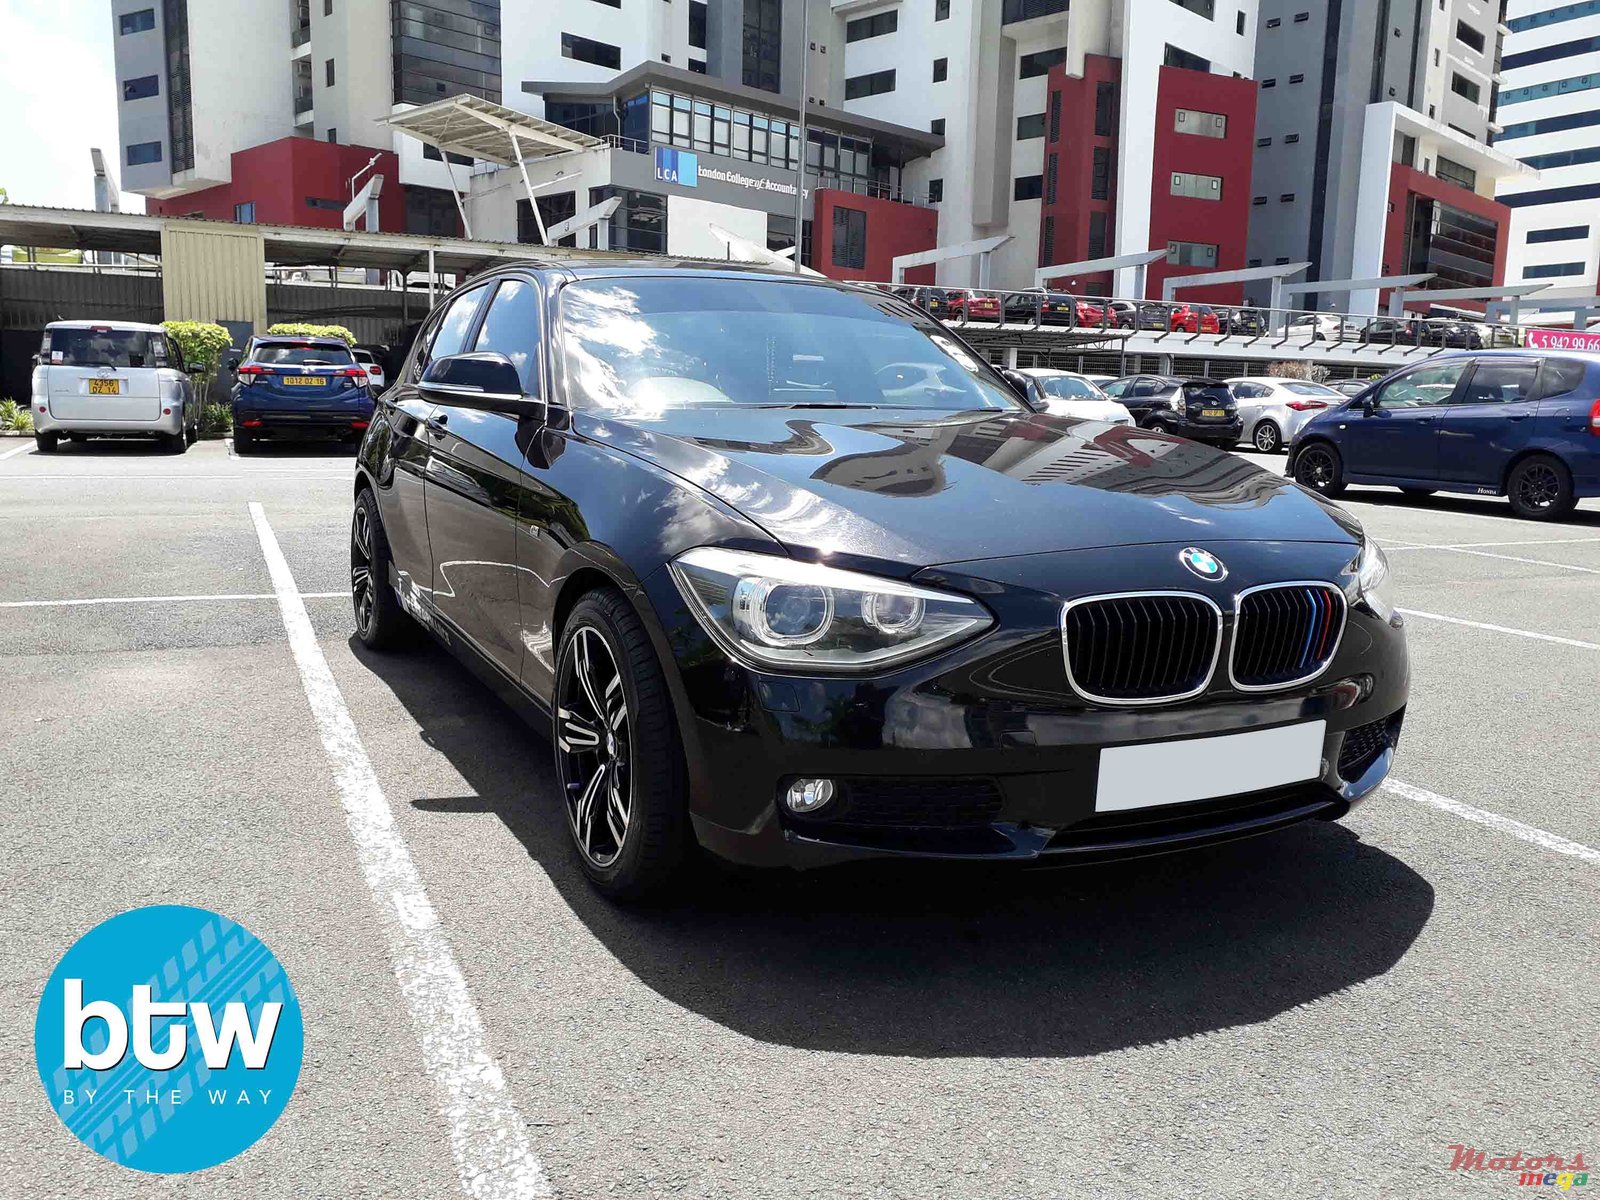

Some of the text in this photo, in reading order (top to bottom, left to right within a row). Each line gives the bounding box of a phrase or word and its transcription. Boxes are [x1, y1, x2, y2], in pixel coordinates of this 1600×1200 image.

[657, 167, 678, 182] LCA
[698, 165, 809, 199] London College of Accountacy
